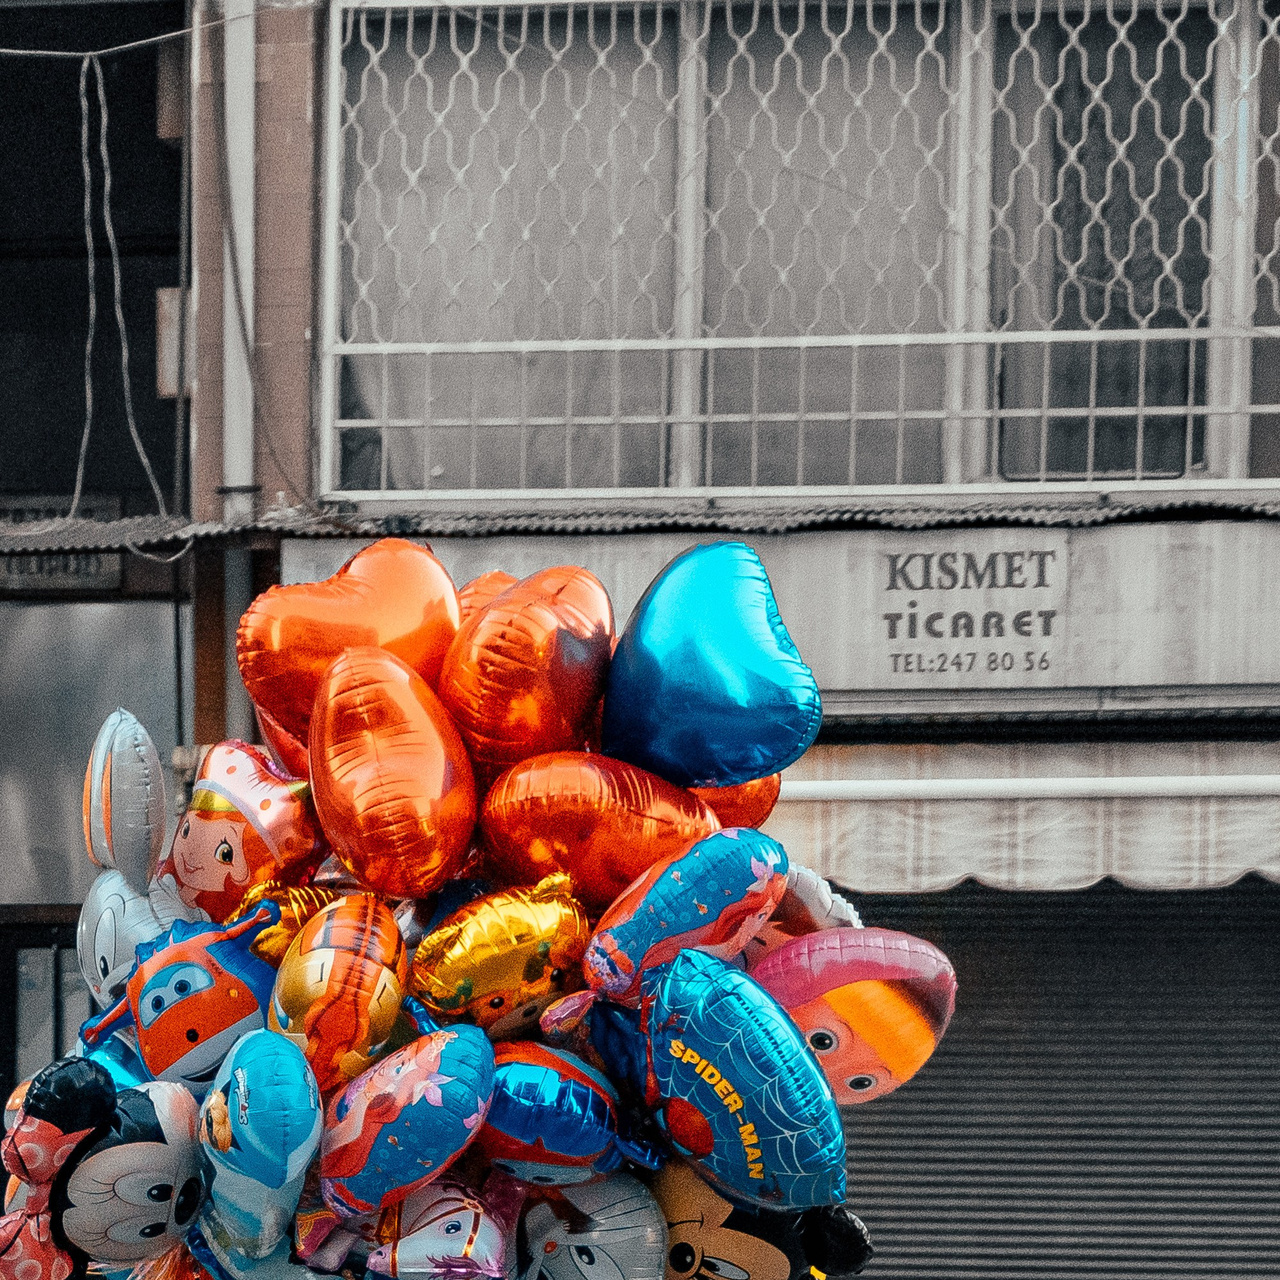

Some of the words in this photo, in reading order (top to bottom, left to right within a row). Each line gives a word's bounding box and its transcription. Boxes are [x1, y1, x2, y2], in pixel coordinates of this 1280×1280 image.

[885, 550, 1056, 591] KISMET
[890, 651, 977, 673] TEL:247
[987, 651, 1015, 671] 80
[1024, 651, 1050, 671] 56
[669, 1039, 765, 1180] SPIDER-MAN
